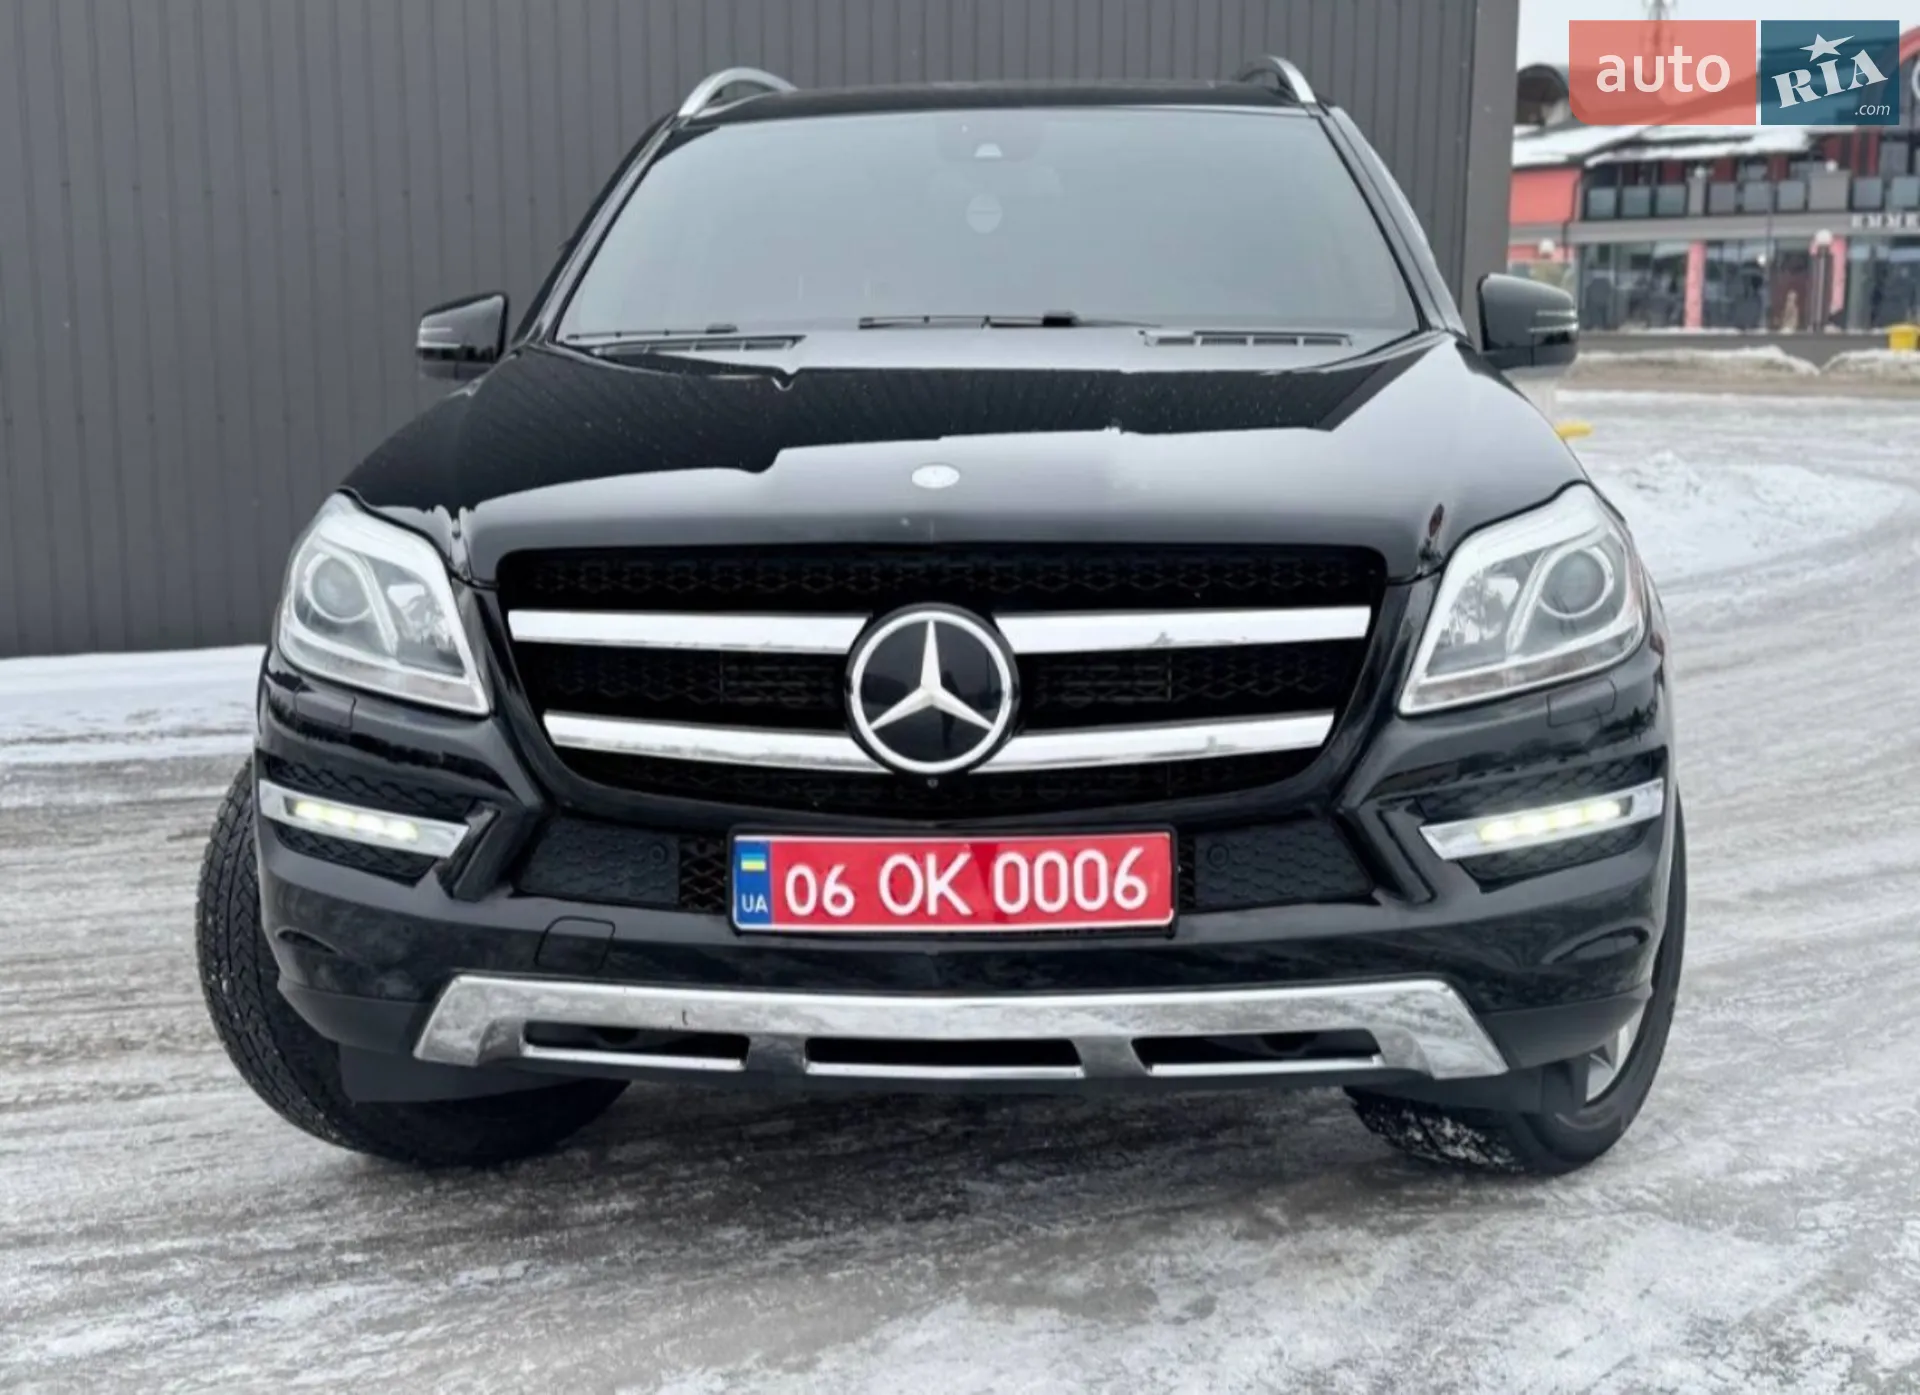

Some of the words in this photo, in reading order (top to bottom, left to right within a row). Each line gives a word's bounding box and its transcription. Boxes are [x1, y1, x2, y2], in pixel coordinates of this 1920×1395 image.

[741, 894, 769, 914] UA
[784, 863, 855, 918] 06
[878, 851, 973, 917] OK
[993, 846, 1149, 915] 0006
